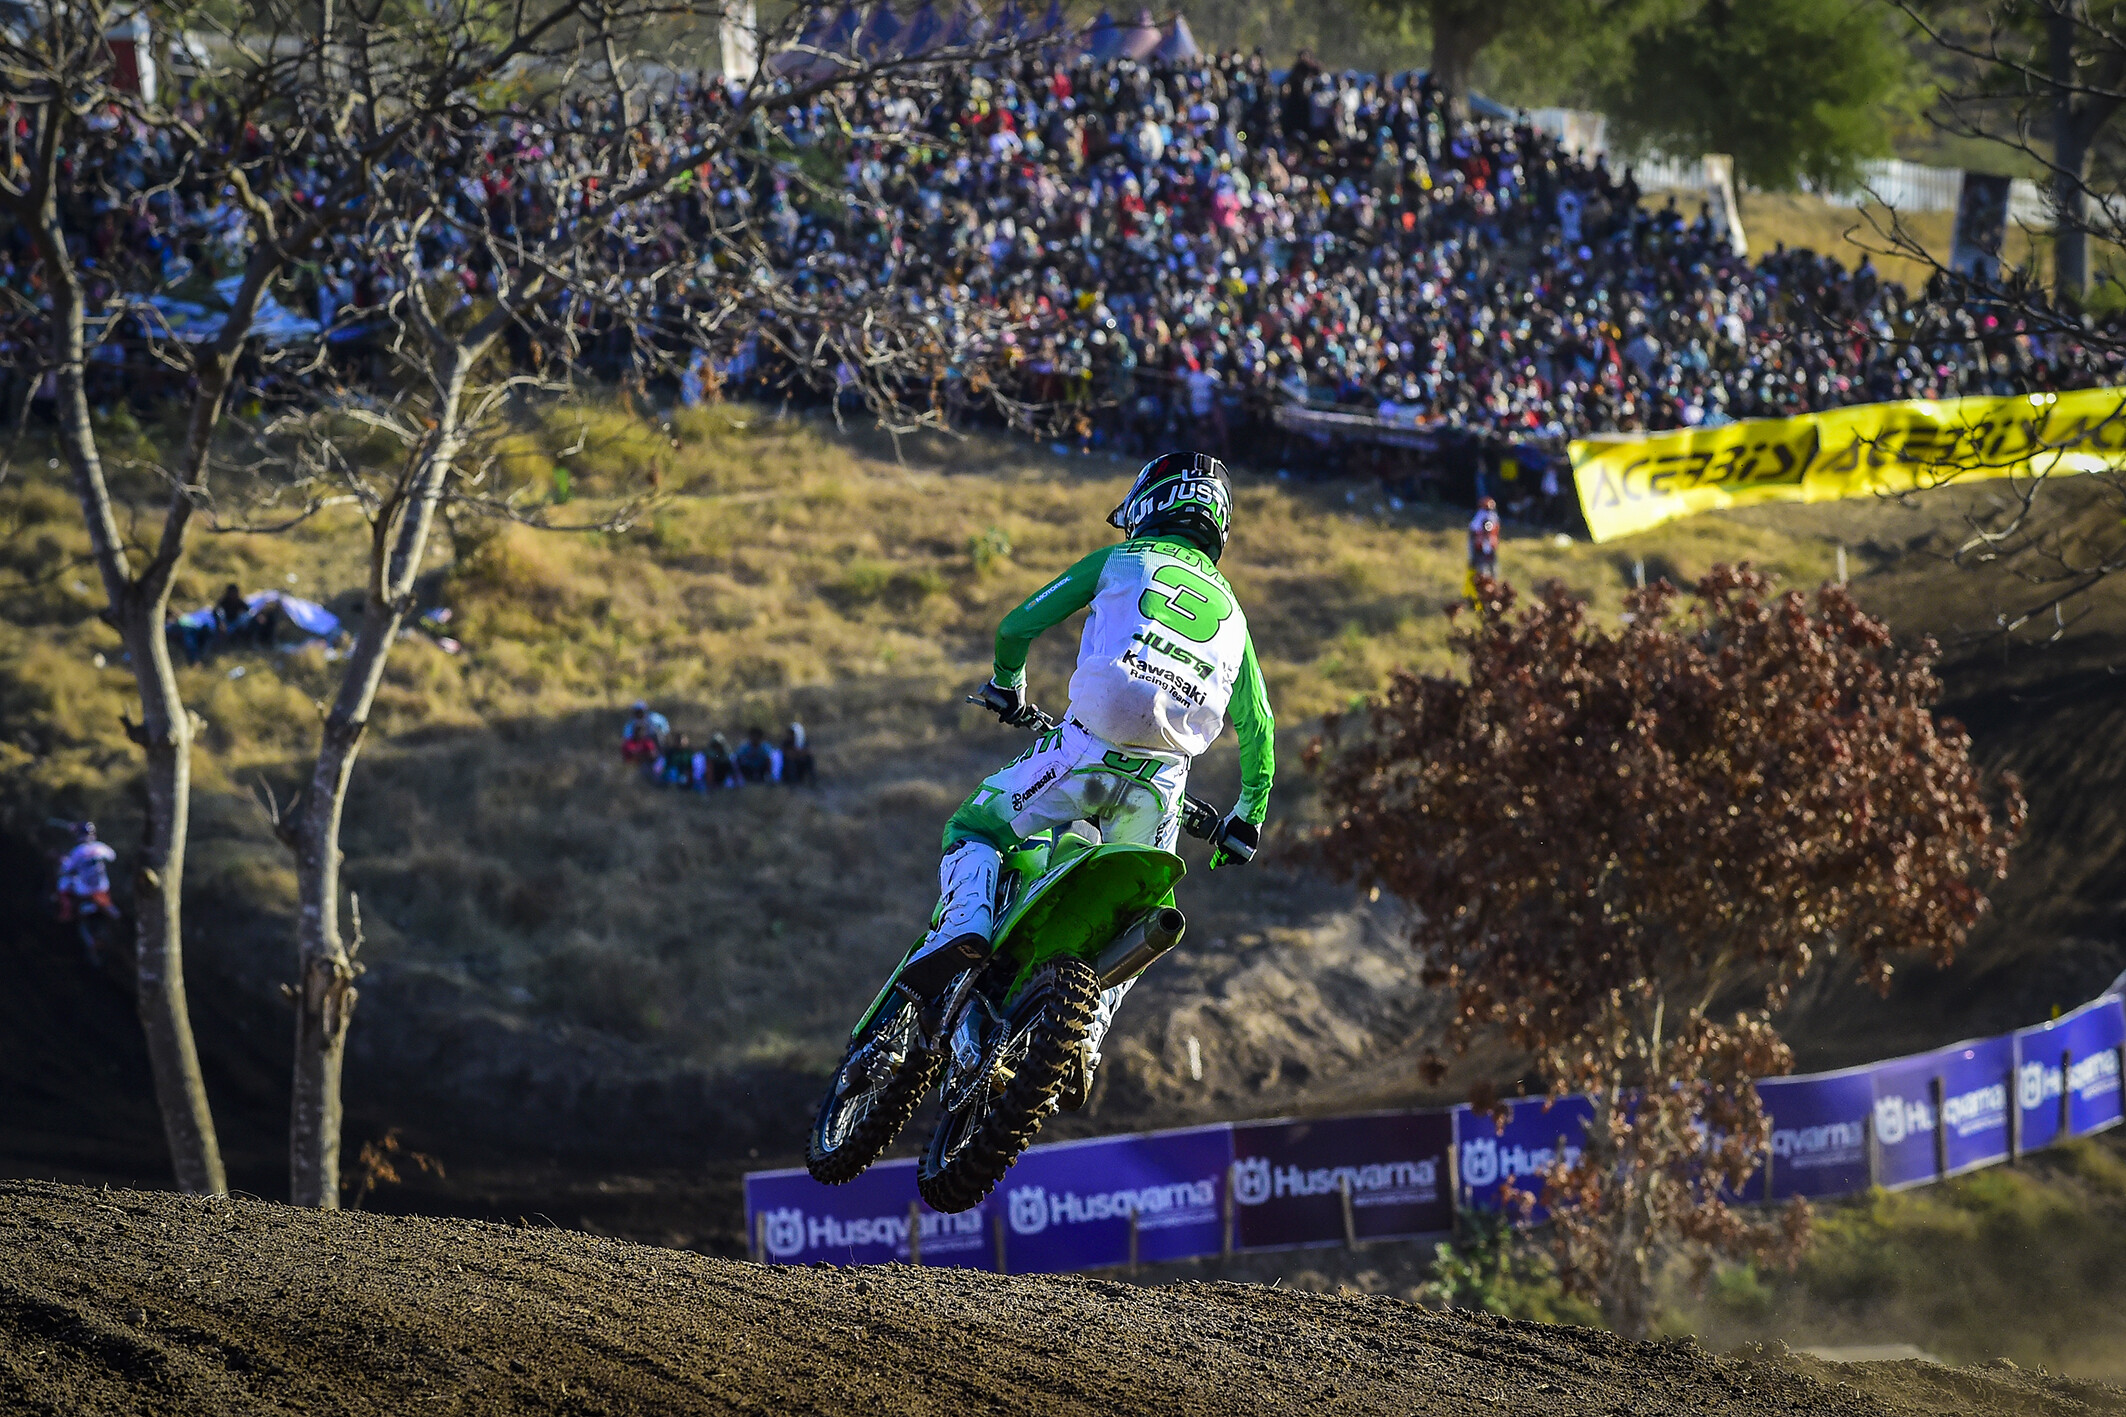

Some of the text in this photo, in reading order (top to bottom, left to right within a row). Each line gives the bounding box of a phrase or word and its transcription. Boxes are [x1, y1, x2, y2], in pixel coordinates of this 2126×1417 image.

[1138, 565, 1233, 643] 3
[1121, 649, 1208, 707] Kawasaki
[1129, 668, 1192, 709] Racing Team
[1273, 1158, 1437, 1198] Husqvarna
[1051, 1179, 1216, 1225] Husqvarna
